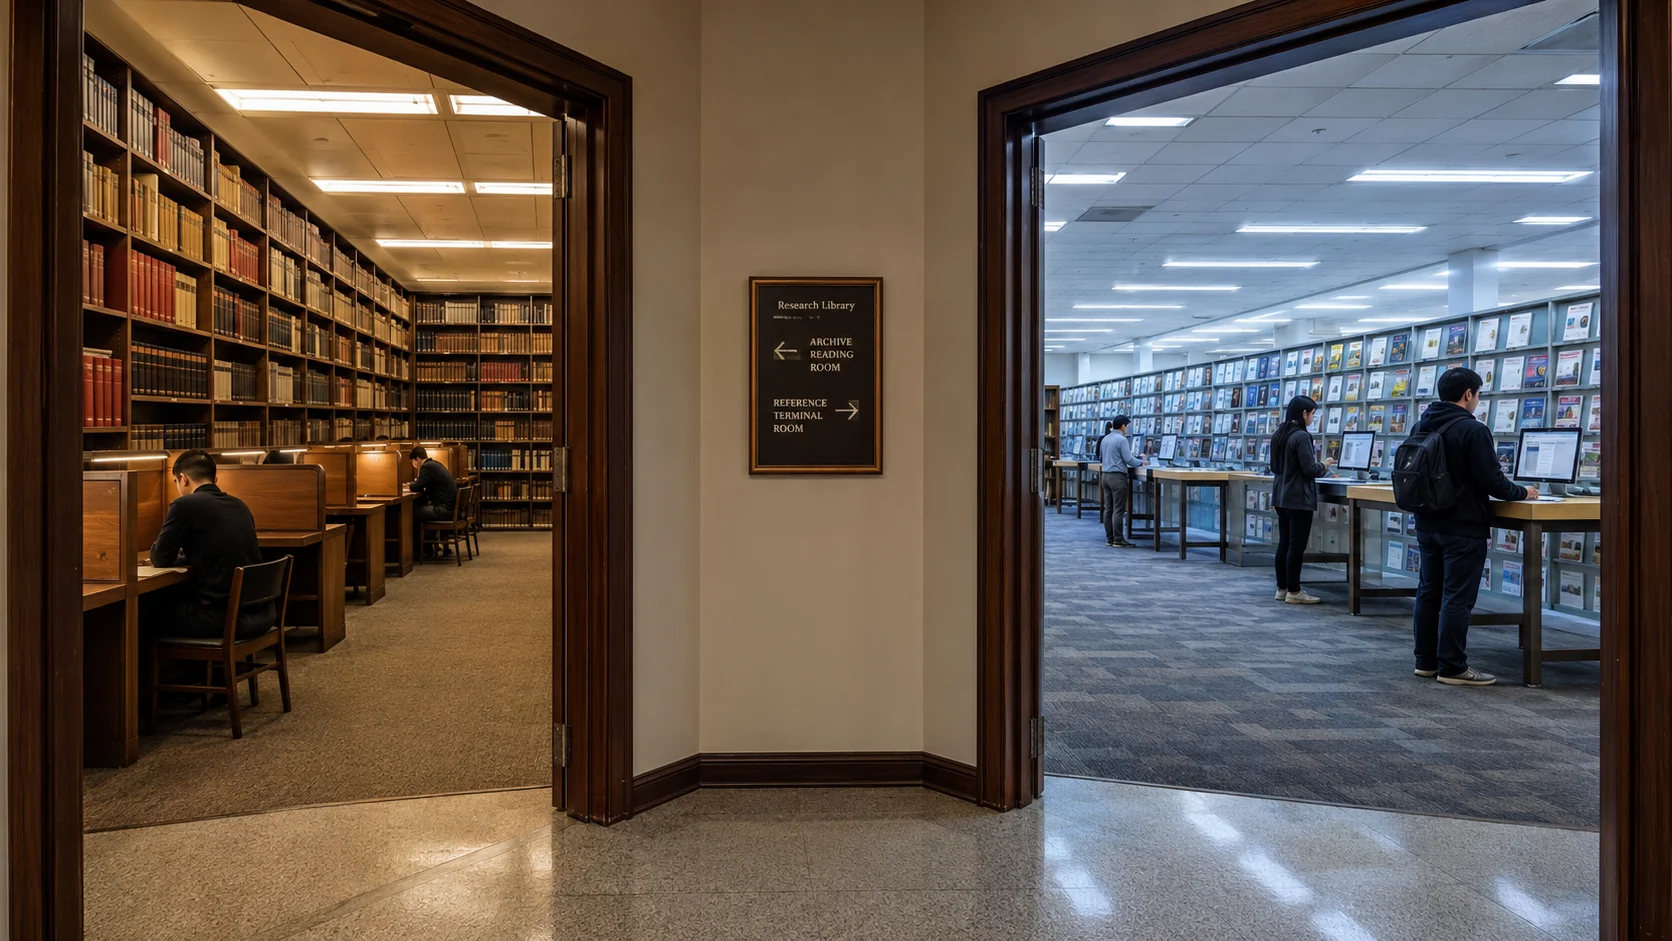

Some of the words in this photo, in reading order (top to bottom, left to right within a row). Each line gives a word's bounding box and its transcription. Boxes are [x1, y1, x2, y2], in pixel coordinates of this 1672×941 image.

[778, 301, 819, 310] Research
[822, 301, 855, 312] Library
[810, 338, 852, 346] ARCHIVE
[810, 350, 854, 359] READING
[810, 363, 841, 372] ROOM
[773, 399, 827, 407] REFERENCE
[773, 411, 823, 420] TERMINAL
[773, 424, 804, 433] ROOM
